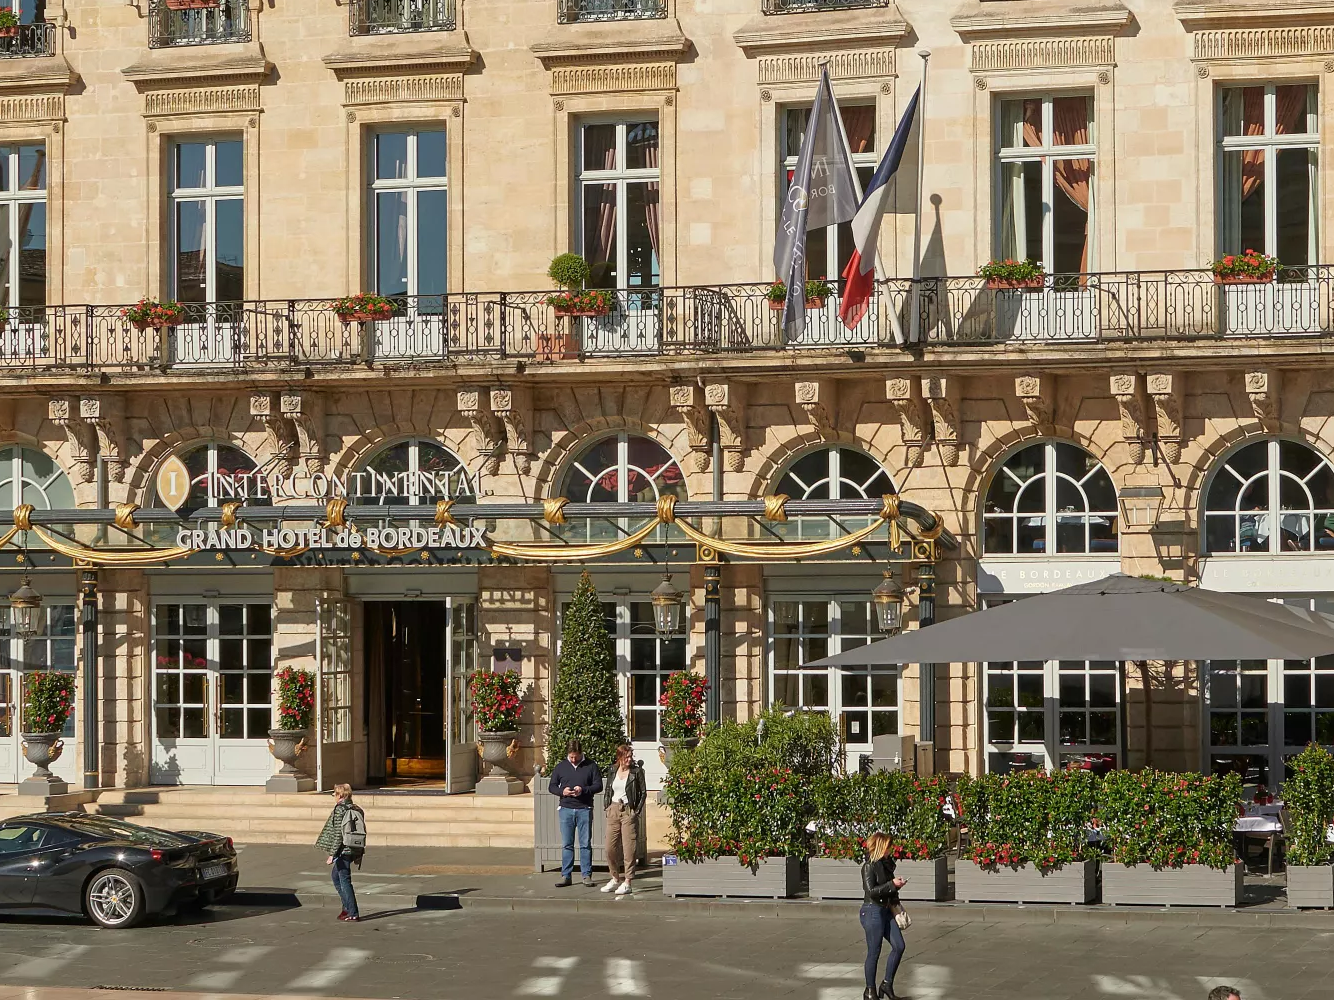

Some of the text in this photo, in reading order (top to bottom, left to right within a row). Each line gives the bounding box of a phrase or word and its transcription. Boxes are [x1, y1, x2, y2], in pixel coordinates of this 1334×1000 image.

[177, 527, 486, 549] GRAND HOTEL de BORDEAUX
[1019, 570, 1106, 579] BORDEAUX
